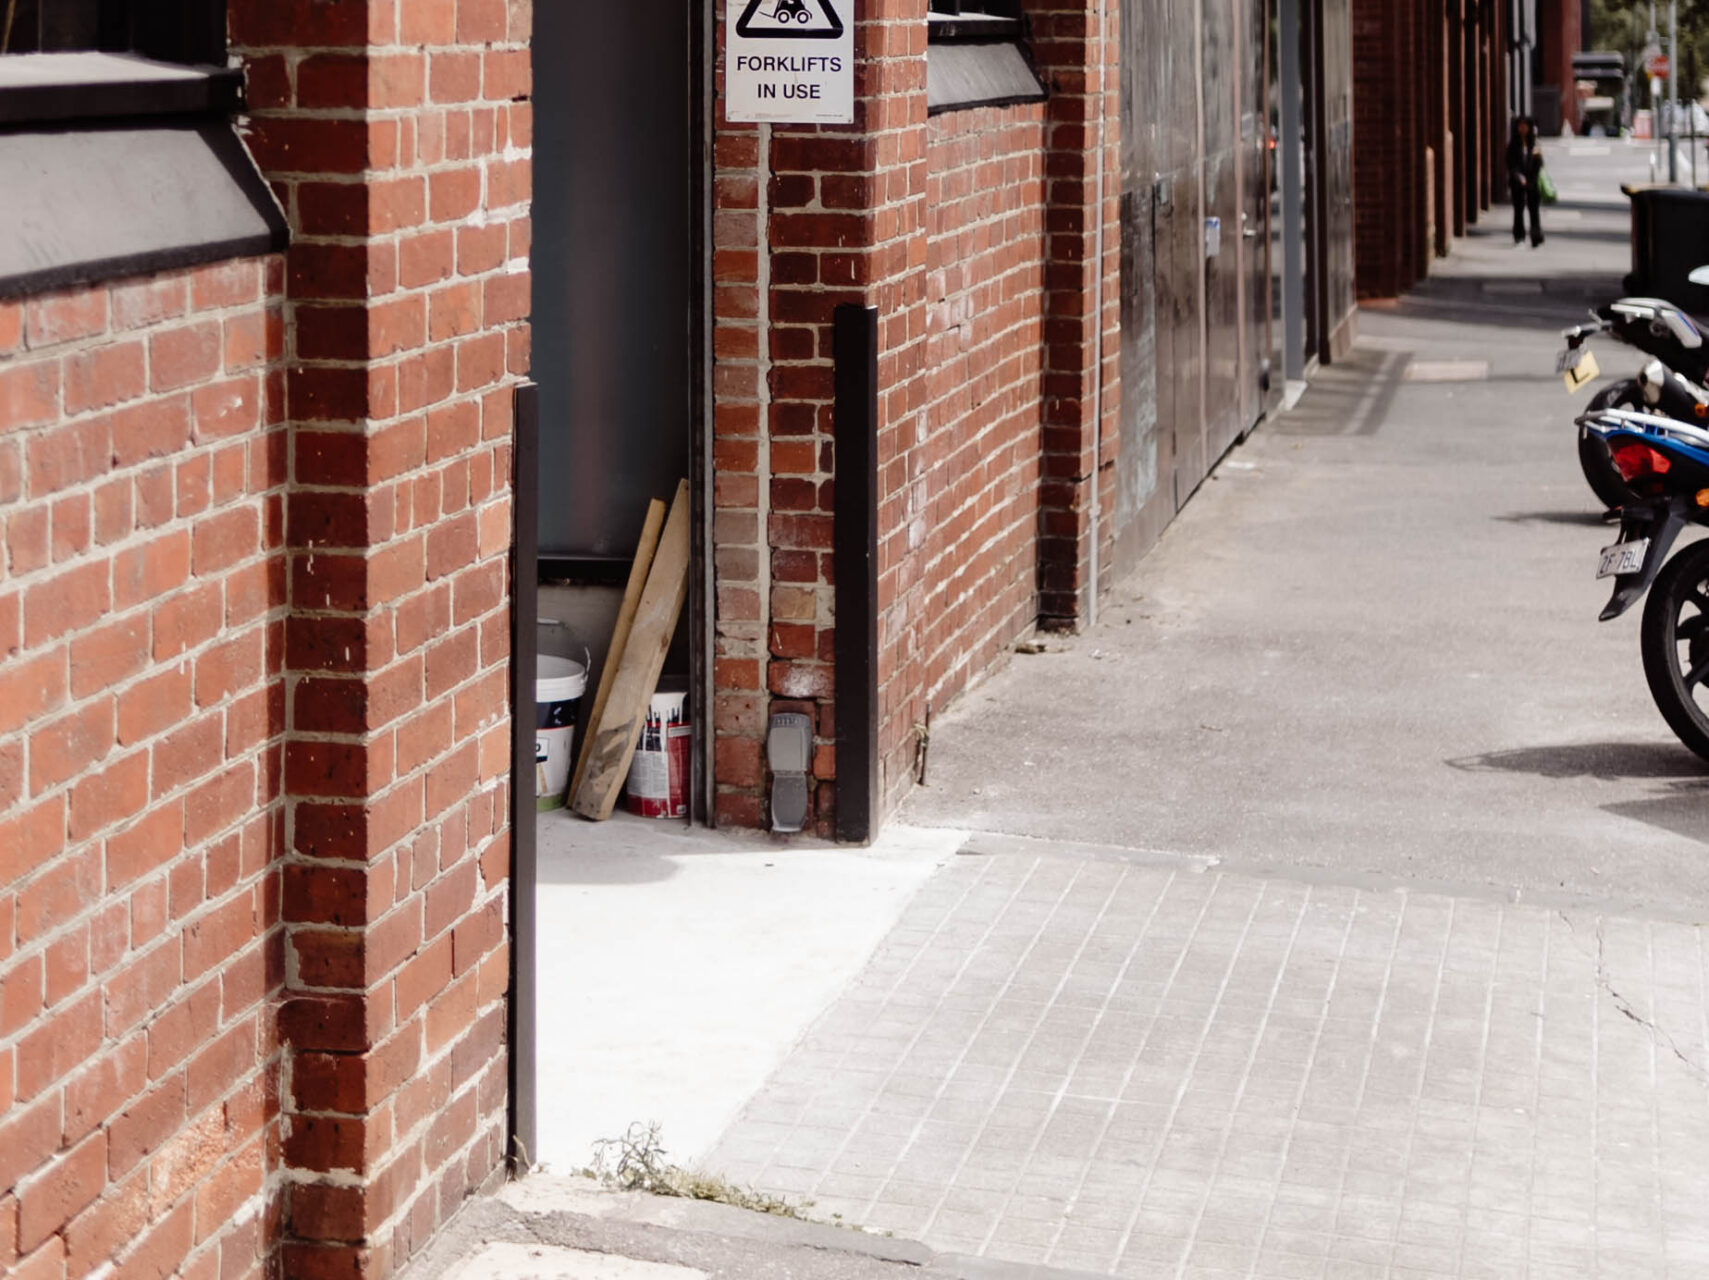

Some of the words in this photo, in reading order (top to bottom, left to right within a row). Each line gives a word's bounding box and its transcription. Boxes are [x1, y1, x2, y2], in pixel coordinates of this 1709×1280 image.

[736, 56, 842, 72] FORKLIFTS
[757, 83, 776, 98] IN
[783, 84, 821, 99] USE
